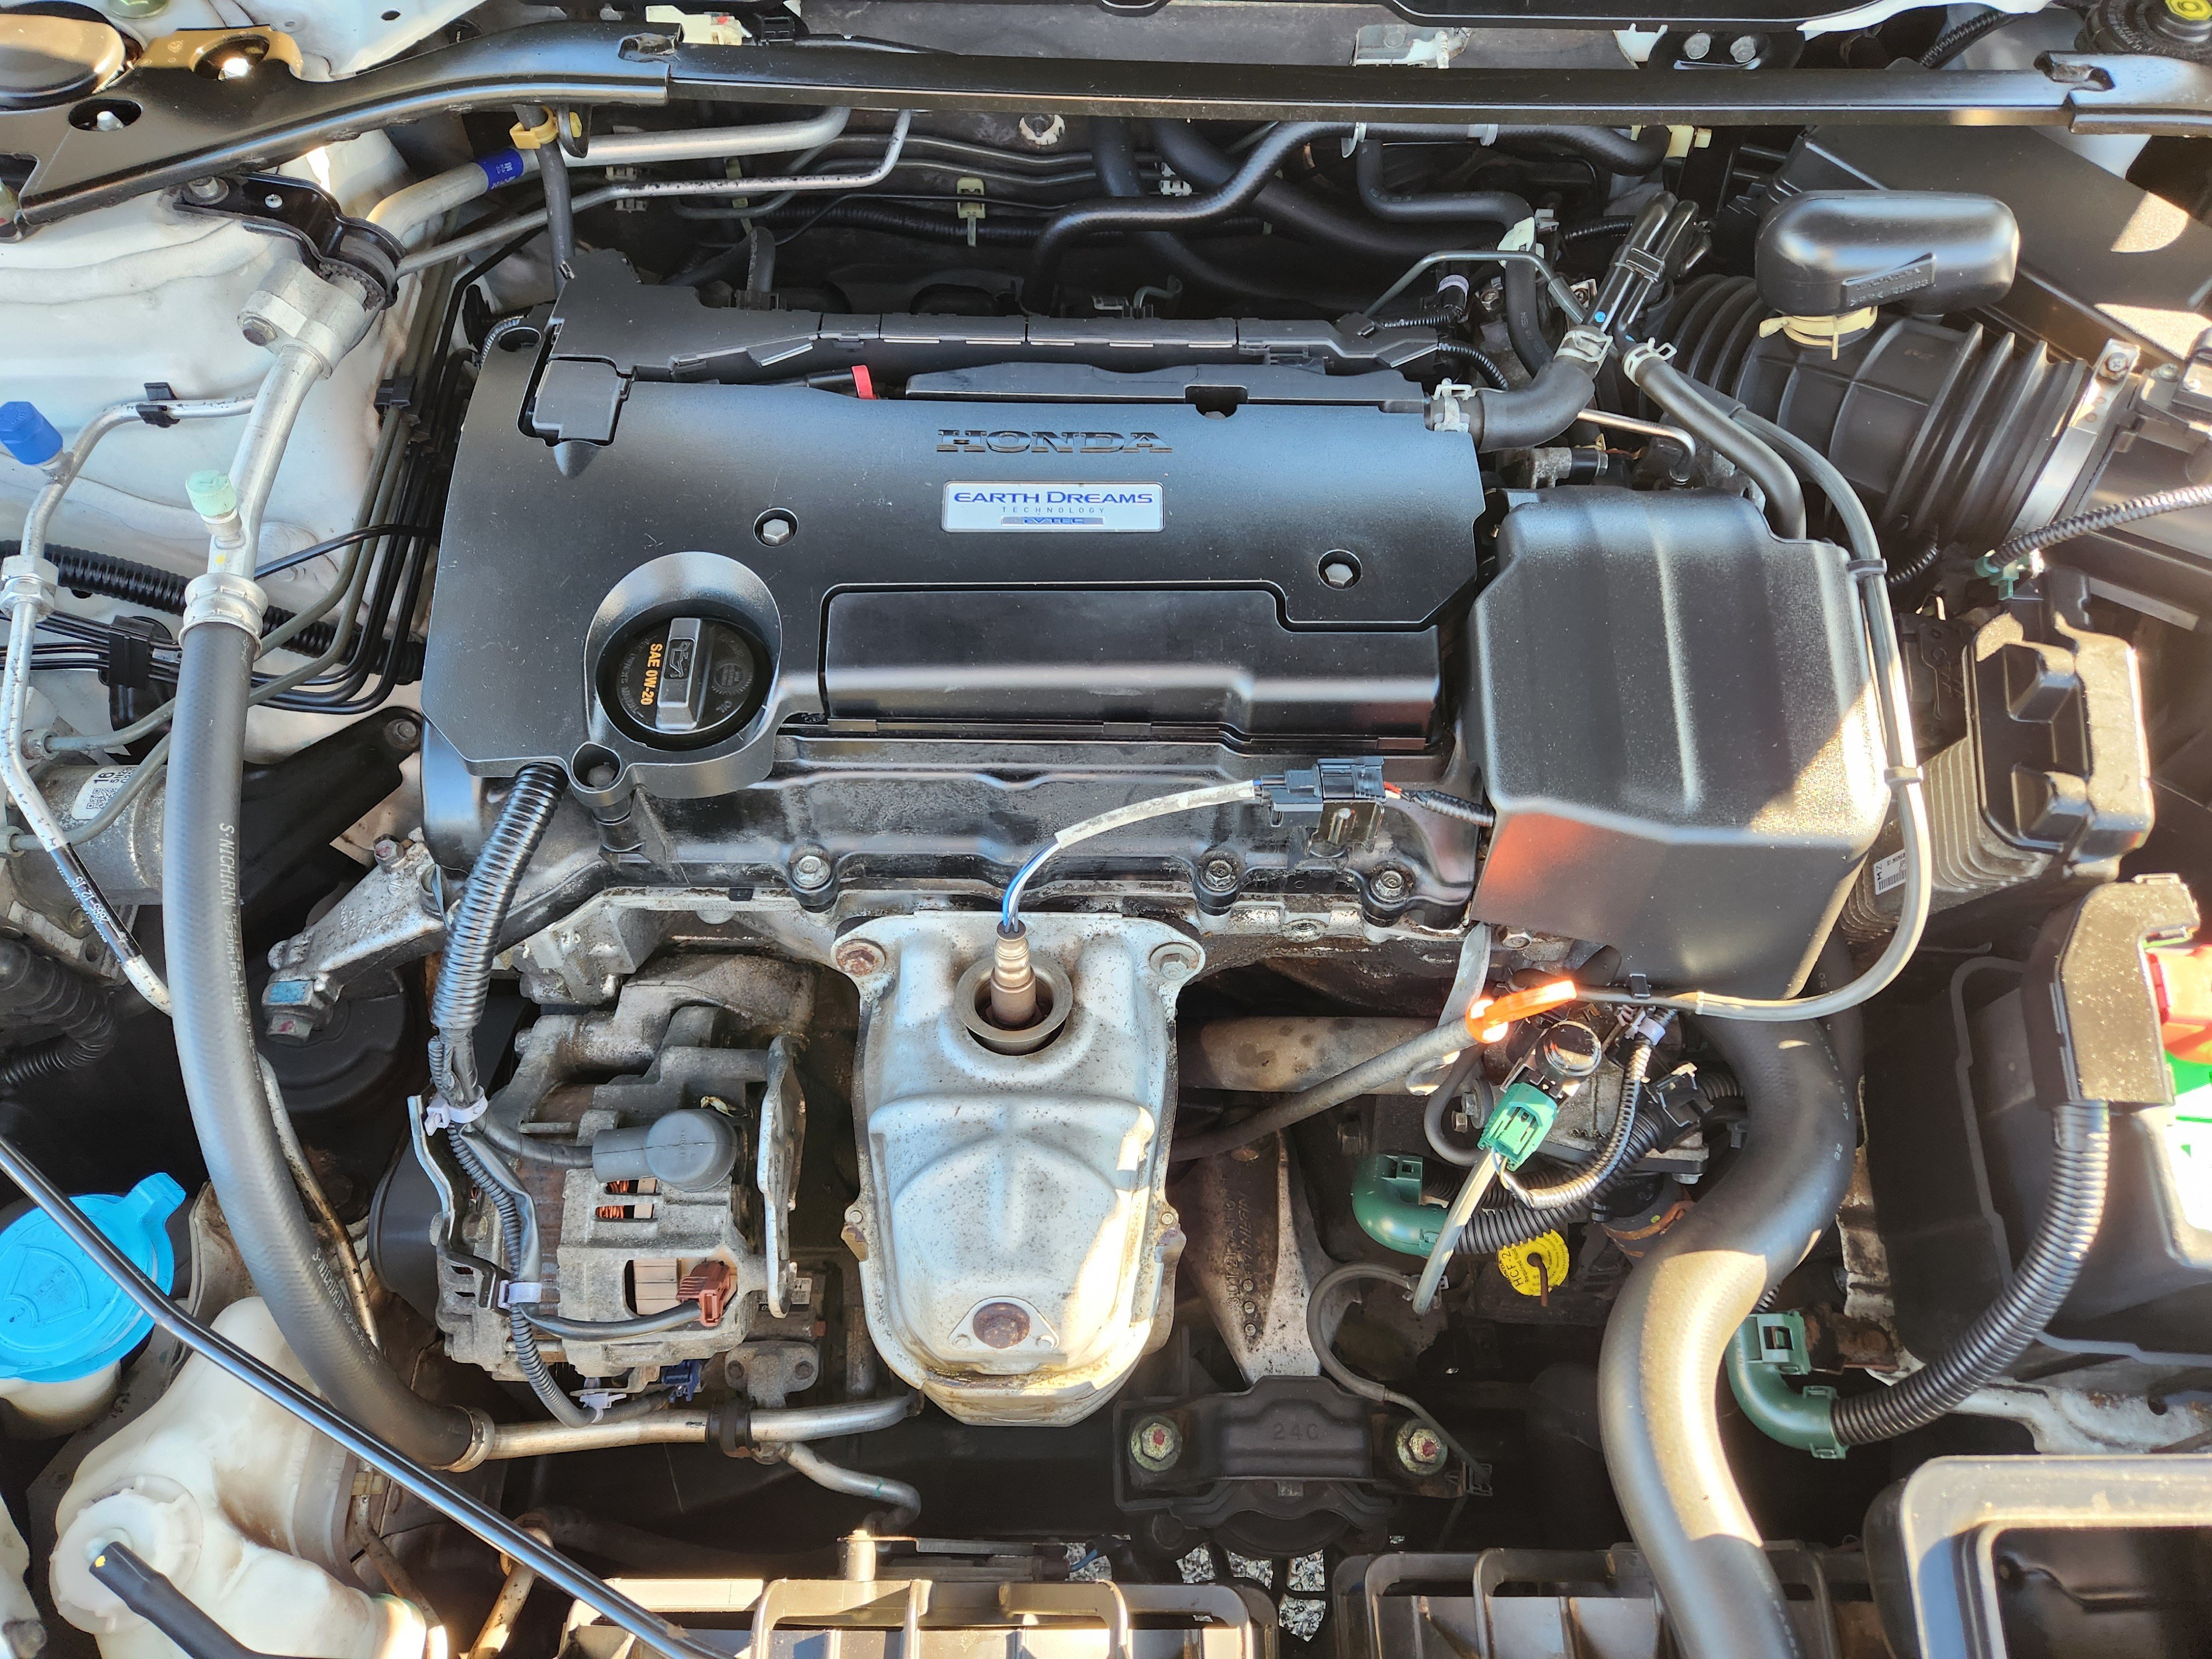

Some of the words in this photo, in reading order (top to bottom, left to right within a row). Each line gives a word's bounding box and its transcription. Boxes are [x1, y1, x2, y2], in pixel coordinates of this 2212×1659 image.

[936, 429, 1173, 453] HONDA
[953, 492, 1040, 504] EARTH
[1047, 491, 1154, 504] DREAMS
[647, 643, 664, 668] SAE
[93, 772, 116, 784] 16
[1501, 1251, 1524, 1287] HCF-2
